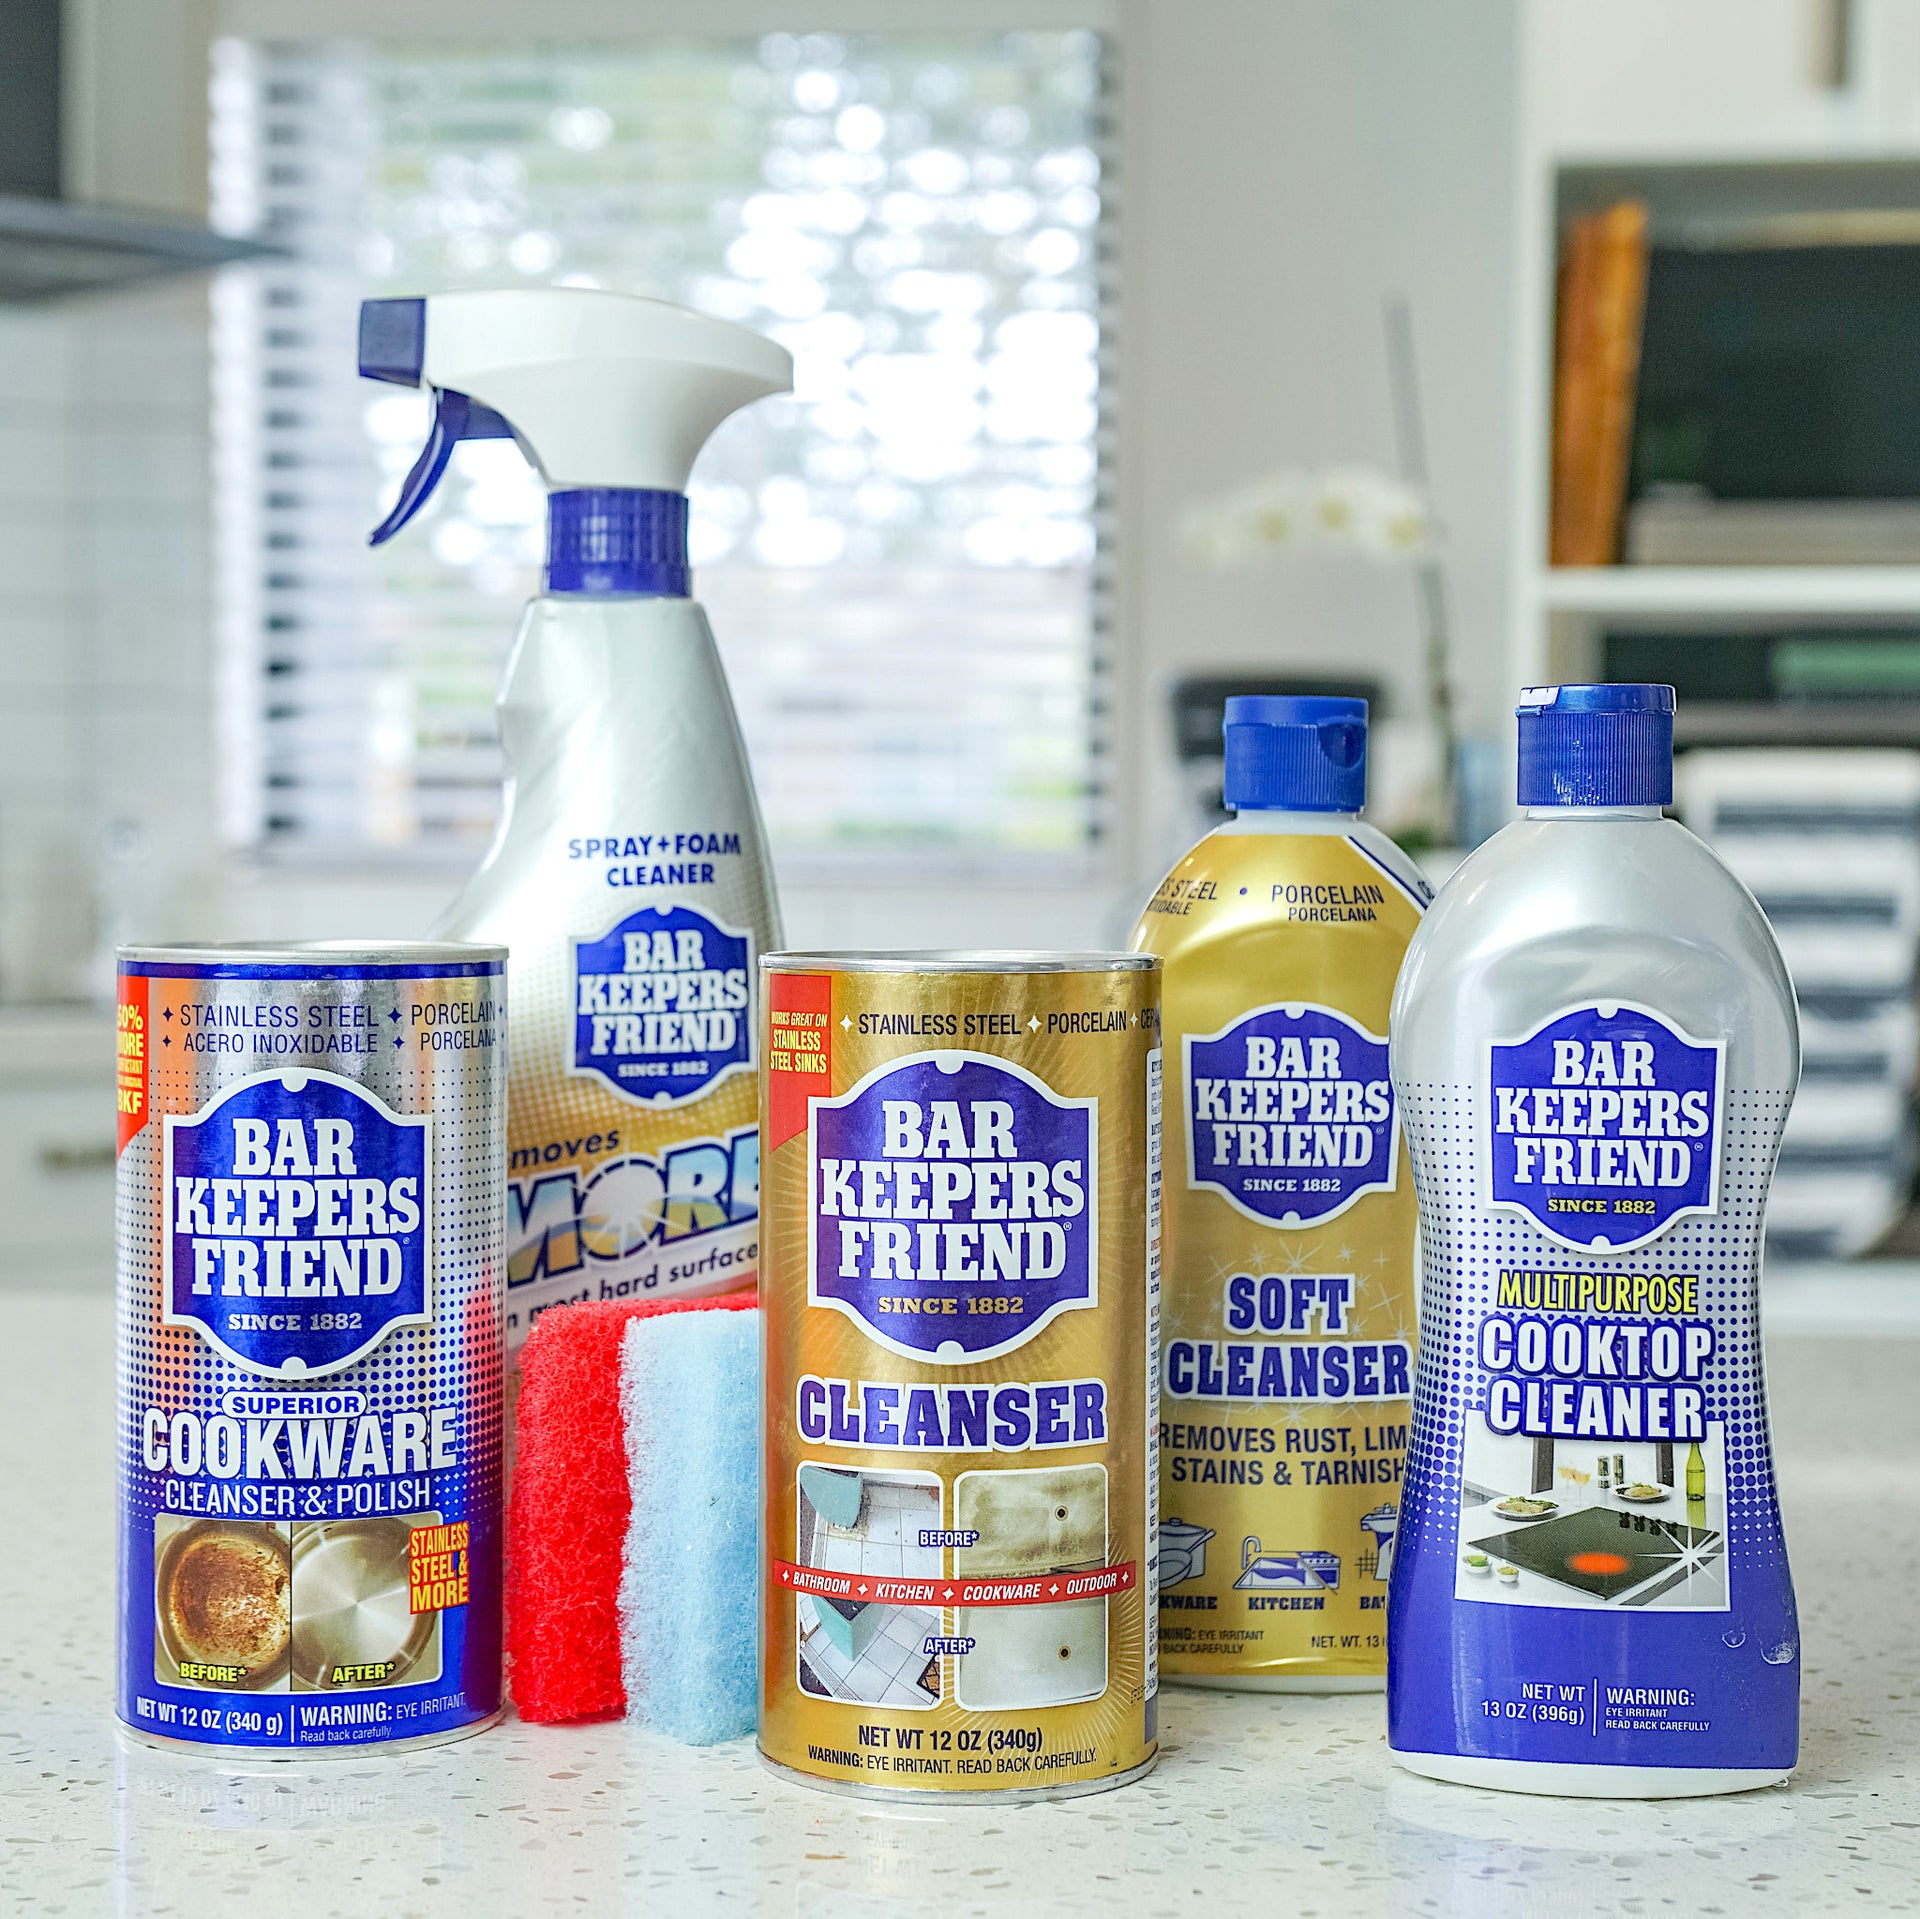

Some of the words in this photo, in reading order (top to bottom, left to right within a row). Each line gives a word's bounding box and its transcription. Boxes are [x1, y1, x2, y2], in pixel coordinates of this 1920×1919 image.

[607, 863, 715, 886] CLEANER
[1171, 879, 1218, 900] STEEL
[1272, 884, 1385, 904] PORCELAIN
[1288, 907, 1377, 922] PORCELANA
[622, 930, 705, 973] BAR
[578, 969, 749, 1017] KEEPERS
[180, 1005, 299, 1028] STAINLESS
[308, 1004, 379, 1027] STEEL
[411, 1002, 496, 1025] PORCELAIN
[771, 1011, 790, 1025] WORKS
[791, 1012, 814, 1027] GREAT
[815, 1013, 828, 1027] ON
[858, 1013, 957, 1036] STAINLESS
[964, 1014, 1021, 1036] STEEL
[1048, 1010, 1127, 1035] PORCELAIN
[184, 1034, 244, 1053] ACERO
[254, 1032, 378, 1053] INOXIDABLE
[420, 1029, 497, 1050] PORCELANA
[591, 1010, 737, 1056] FRIEND
[773, 1029, 821, 1051] STAINLESS
[618, 1062, 669, 1078] SINCE
[672, 1061, 709, 1076] 1882
[770, 1050, 793, 1071] STEEL
[795, 1052, 827, 1074] SINKS
[1245, 1037, 1341, 1079] BAR
[1552, 1040, 1655, 1087] BAR
[1195, 1078, 1389, 1122] KEEPERS
[1495, 1087, 1709, 1138] KEEPERS
[882, 1100, 1017, 1159] BAR
[1213, 1123, 1373, 1168] FRIEND
[232, 1118, 357, 1176] BAR
[1513, 1137, 1691, 1187] FRIEND
[820, 1160, 1085, 1220] KEEPERS
[1243, 1178, 1297, 1192] SINCE
[1303, 1178, 1341, 1192] 1882
[176, 1177, 419, 1237] KEEPERS
[1547, 1199, 1607, 1214] SINCE
[1613, 1200, 1656, 1215] 1882
[191, 1238, 402, 1297] FRIEND
[838, 1221, 1067, 1281] FRIEND
[601, 1264, 658, 1300] hard
[1498, 1271, 1698, 1313] MULTIPURPOSE
[879, 1297, 957, 1315] SINCE
[967, 1297, 1023, 1314] 1882
[1228, 1276, 1350, 1332] SOFT
[229, 1314, 301, 1331] SINCE
[310, 1313, 362, 1330] 1882
[1481, 1319, 1714, 1379] COOKTOP
[1168, 1342, 1411, 1398] CLEANSER
[232, 1396, 360, 1415] SUPERIOR
[800, 1377, 1107, 1450] CLEANSER
[1489, 1379, 1703, 1438] CLEANER
[143, 1407, 461, 1480] COOKWARE
[1159, 1422, 1276, 1453] REMOVES
[1286, 1427, 1357, 1457] RUST,
[1172, 1458, 1264, 1486] STAINS
[1273, 1461, 1292, 1486] &
[1301, 1457, 1405, 1486] TARNISH
[165, 1480, 295, 1515] CLEANSER
[304, 1485, 328, 1515] &
[337, 1478, 430, 1514] POLISH
[410, 1522, 469, 1557] STAINLESS
[410, 1555, 455, 1585] STEEL
[458, 1552, 468, 1577] &
[412, 1580, 469, 1613] MORE
[792, 1571, 851, 1595] BATHROOM
[875, 1583, 935, 1601] KITCHEN
[963, 1583, 1041, 1601] COOKWARE
[1066, 1575, 1117, 1595] OUTDOOR
[1248, 1597, 1325, 1610] KITCHEN
[1189, 1643, 1245, 1654] CAREFULLY
[1198, 1630, 1217, 1641] EYE
[1219, 1630, 1264, 1641] IRRITANT
[1311, 1635, 1337, 1648] NET.
[1340, 1635, 1362, 1648] WT.
[1366, 1635, 1380, 1648] 13
[1522, 1683, 1554, 1701] NET
[1559, 1685, 1586, 1702] WT
[1606, 1687, 1696, 1706] WARNING:
[137, 1696, 155, 1716] NET
[158, 1702, 178, 1722] WT
[180, 1706, 197, 1726] 12
[201, 1709, 220, 1730] OZ
[225, 1712, 263, 1734] (340
[266, 1714, 283, 1736] g)
[300, 1706, 393, 1727] WARNING:
[396, 1703, 418, 1720] EYE
[421, 1692, 466, 1718] IRRITANT.
[1481, 1701, 1500, 1717] 13
[1505, 1702, 1527, 1719] OZ
[1532, 1703, 1585, 1726] (396g)
[1605, 1720, 1630, 1730] READ
[1633, 1720, 1657, 1731] BACK
[1660, 1721, 1710, 1732] CAREFULLY
[1606, 1708, 1623, 1718] EYE
[1626, 1708, 1668, 1718] IRRITANT
[300, 1729, 325, 1742] Read
[327, 1728, 350, 1741] back
[352, 1725, 393, 1742] carefully.
[859, 1726, 890, 1747] NET
[895, 1730, 924, 1750] WT
[929, 1730, 952, 1750] 12
[957, 1731, 982, 1751] OZ
[987, 1726, 1043, 1753] (340g)
[808, 1745, 863, 1769] WARNING:
[867, 1755, 890, 1771] EYE
[893, 1757, 954, 1774] IRRITANT.
[957, 1758, 991, 1774] READ
[996, 1757, 1031, 1773] BACK
[1035, 1748, 1097, 1770] CAREFULLY.
